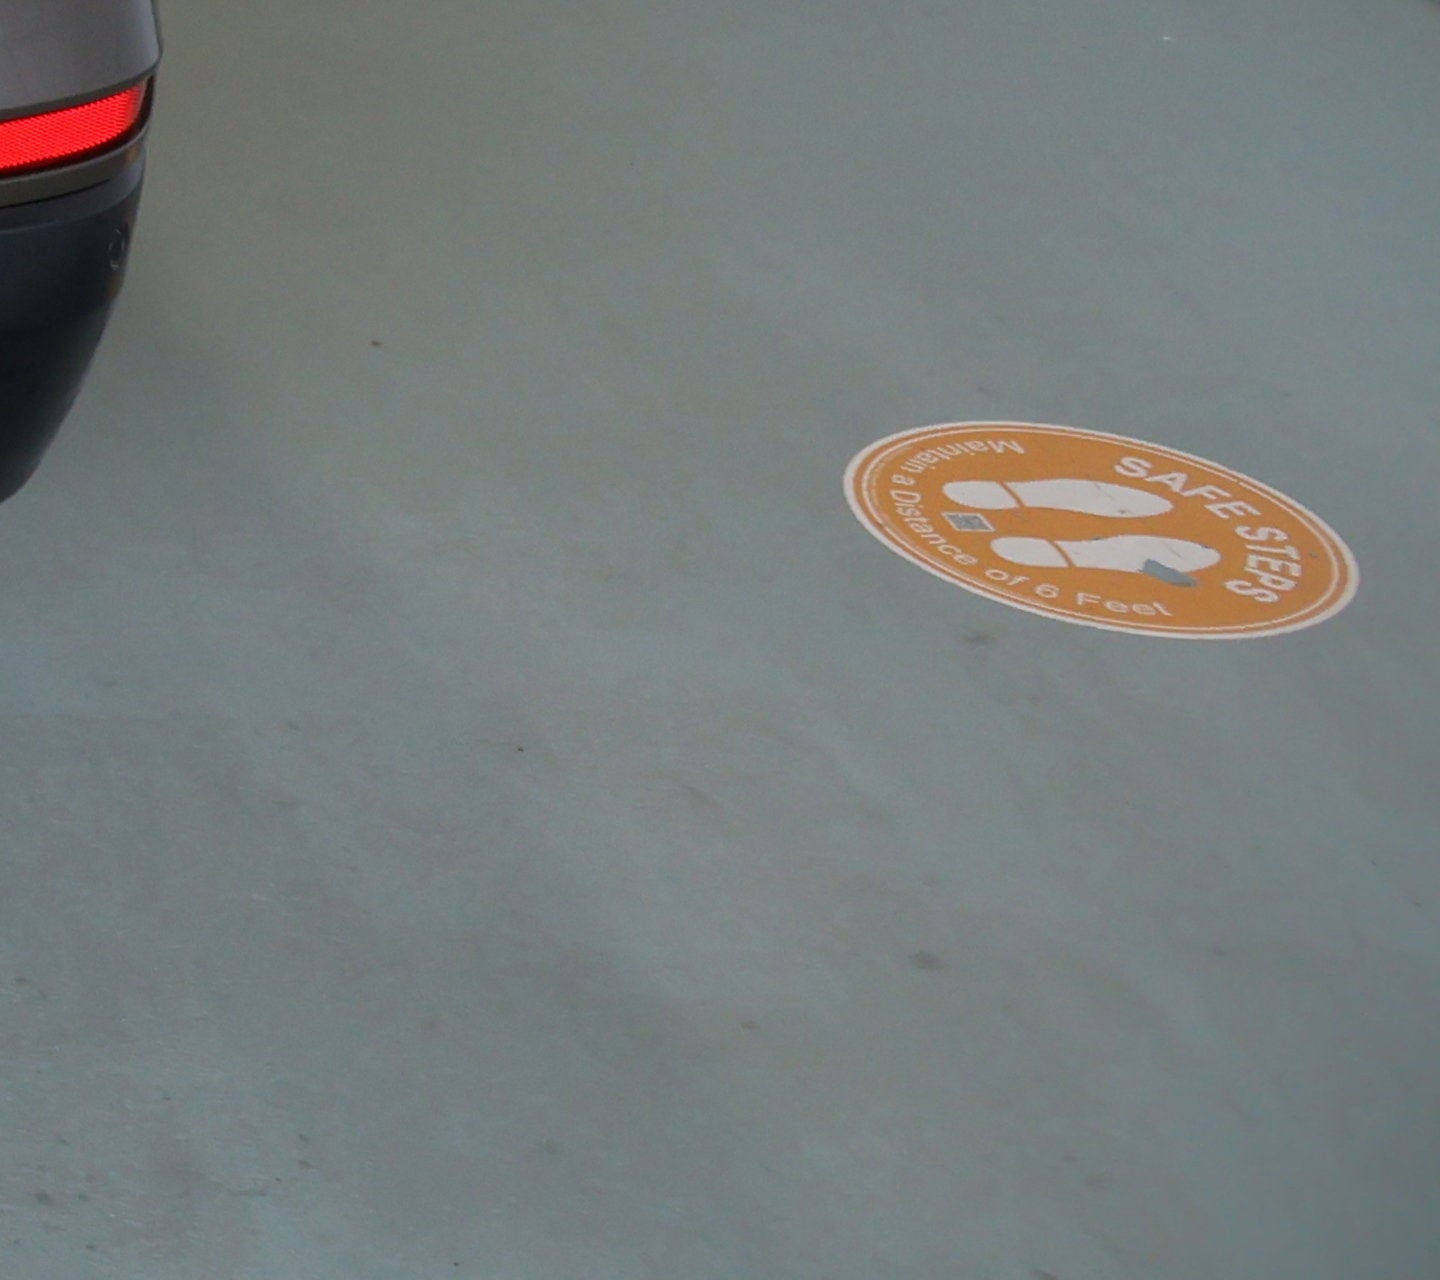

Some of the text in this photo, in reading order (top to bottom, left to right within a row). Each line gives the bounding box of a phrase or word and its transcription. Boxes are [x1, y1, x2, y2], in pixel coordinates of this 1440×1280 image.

[889, 440, 1174, 618] Maintain a Distance of 6 Feet
[1113, 456, 1307, 605] SAFE STEPS
